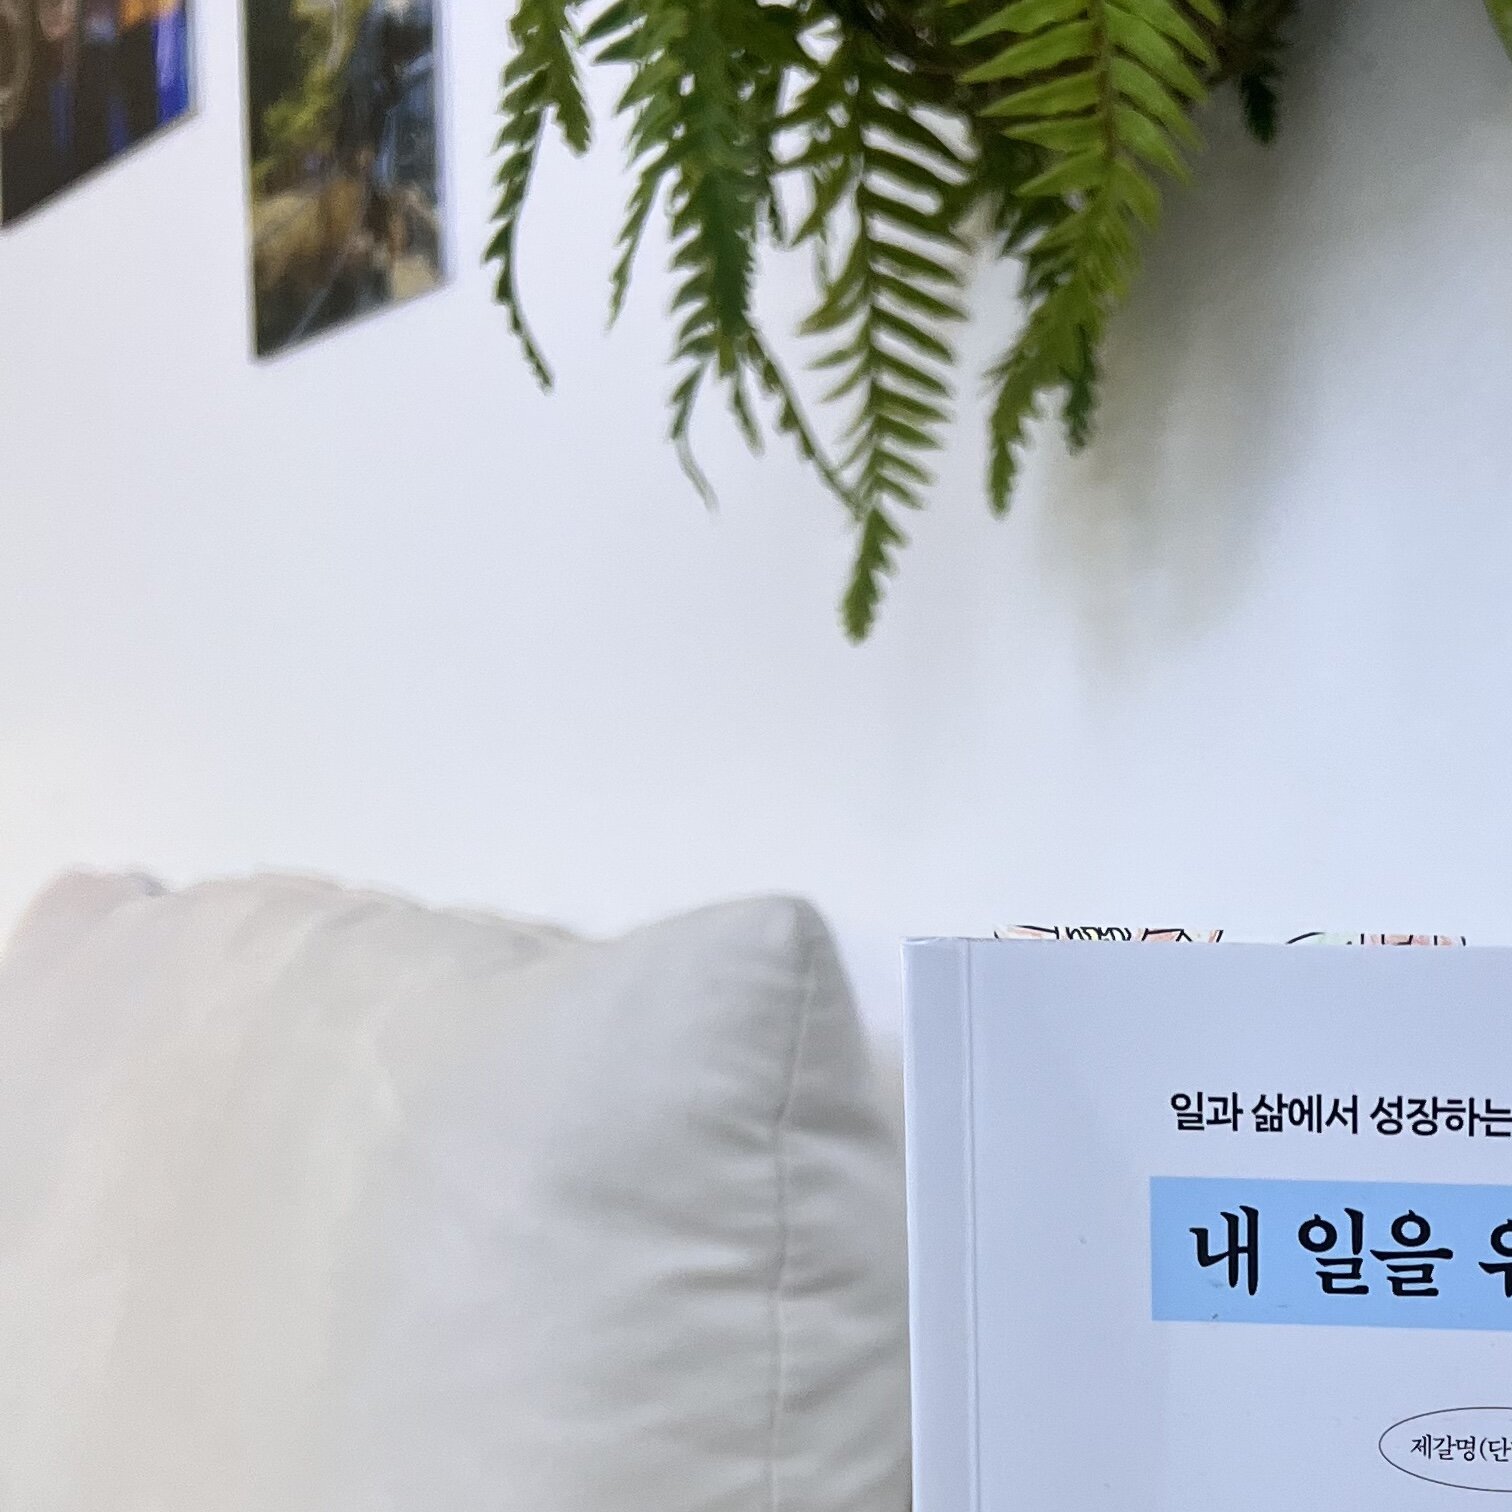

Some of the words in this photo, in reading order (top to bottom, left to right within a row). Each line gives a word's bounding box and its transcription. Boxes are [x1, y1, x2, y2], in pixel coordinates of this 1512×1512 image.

[1170, 1091, 1244, 1132] 일과
[1251, 1093, 1359, 1135] 삶에서
[1189, 1205, 1259, 1296] 내
[1297, 1207, 1454, 1297] 일을
